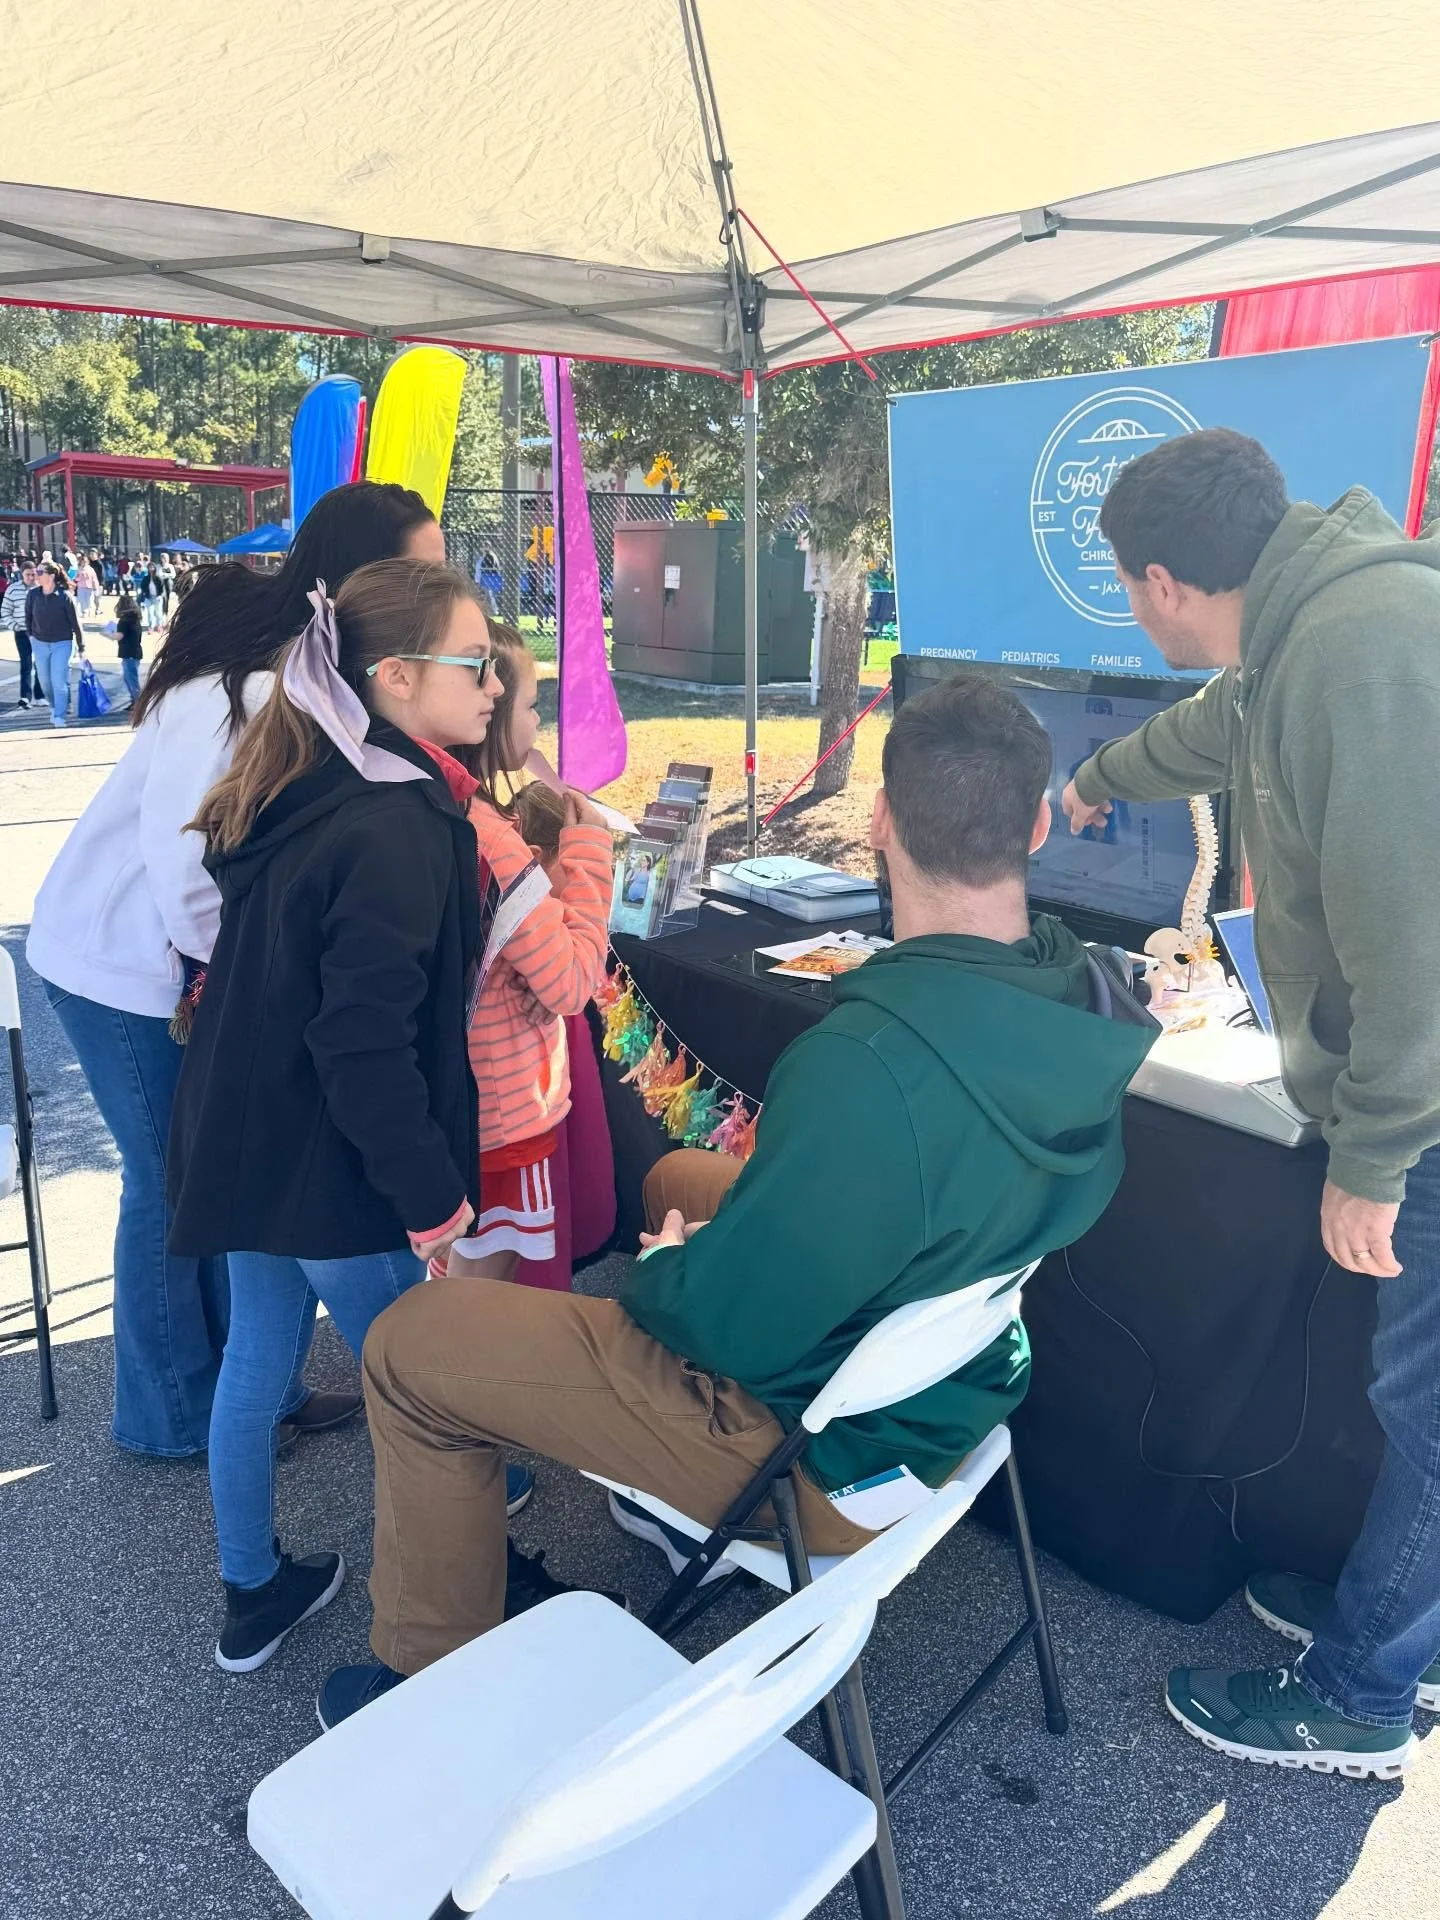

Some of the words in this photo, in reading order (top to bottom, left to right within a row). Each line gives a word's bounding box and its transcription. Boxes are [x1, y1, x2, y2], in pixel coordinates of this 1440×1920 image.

[1038, 511, 1056, 522] EST
[1101, 580, 1121, 596] JAX
[920, 647, 978, 660] PREGNANCY
[1001, 651, 1060, 664] PEDIATRICS
[1091, 654, 1142, 668] FAMILIES
